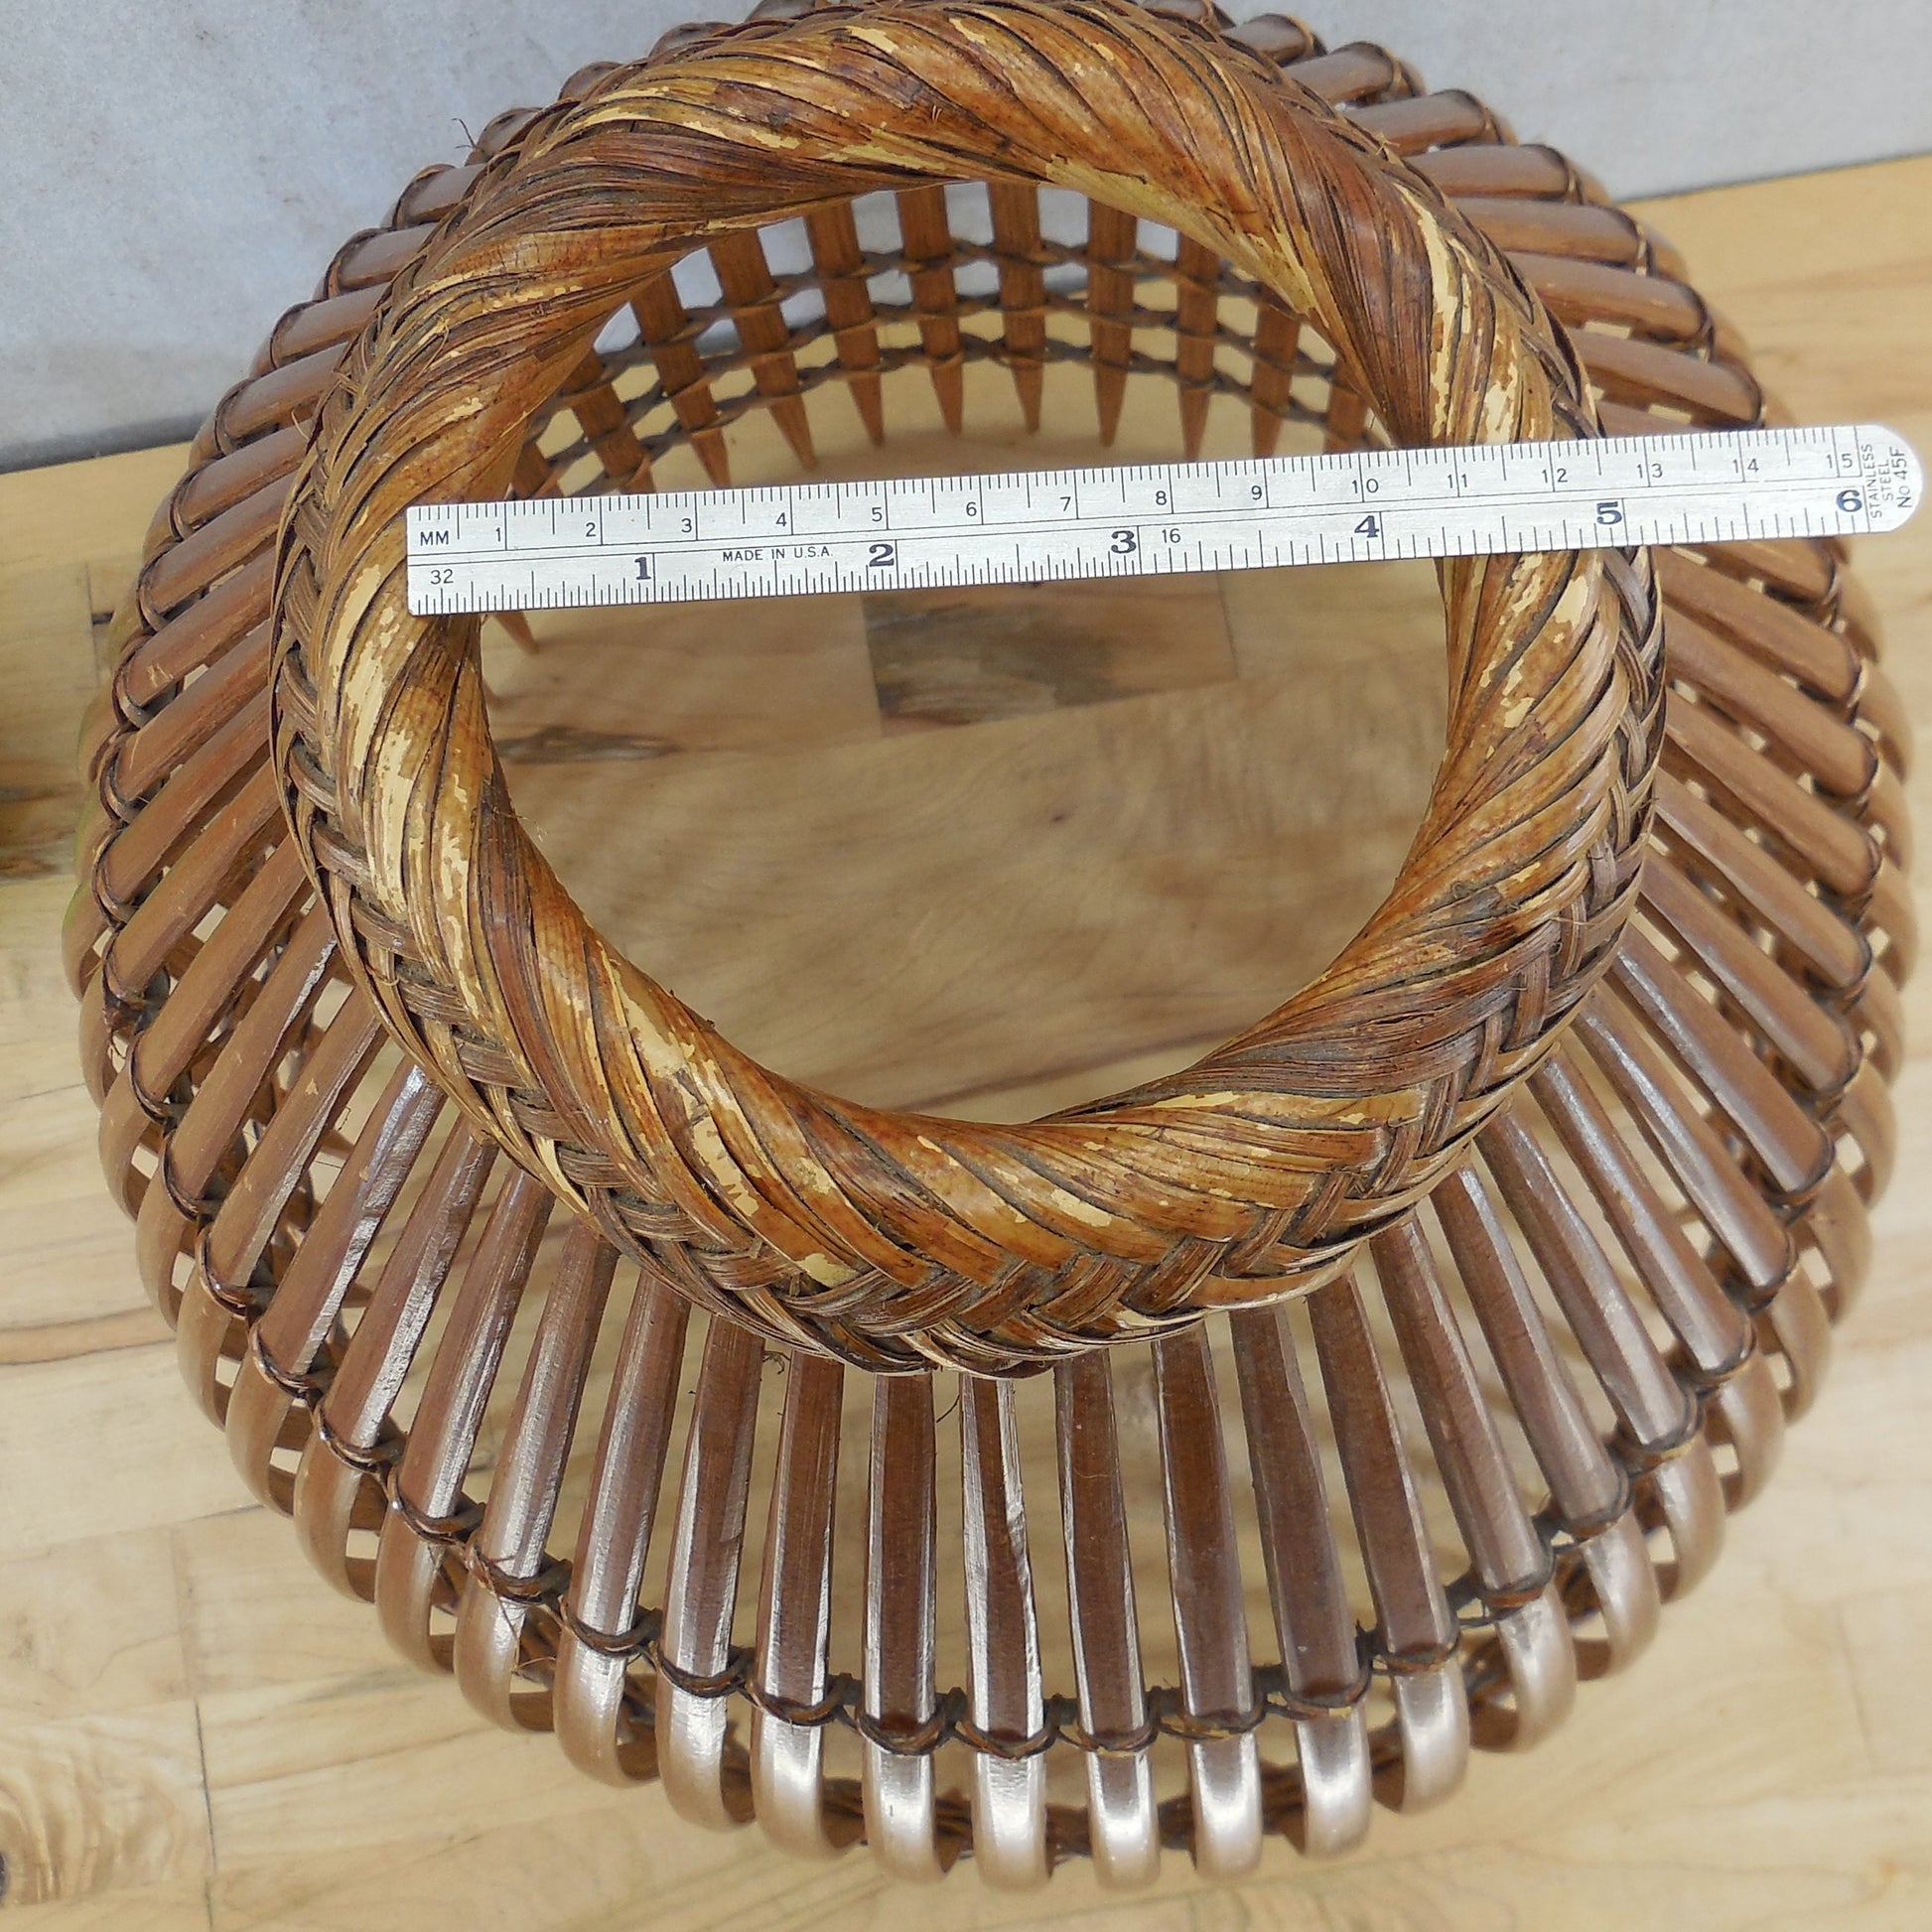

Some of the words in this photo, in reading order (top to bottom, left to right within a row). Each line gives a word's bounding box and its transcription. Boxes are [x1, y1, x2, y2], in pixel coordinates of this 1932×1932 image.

[1861, 444, 1882, 518] STAINLESS
[1878, 459, 1894, 501] STEEL
[1889, 446, 1908, 481] 45F
[420, 530, 450, 546] MM
[495, 526, 501, 542] 1
[586, 522, 597, 537] 2
[681, 517, 692, 533] 3
[775, 512, 787, 527] 4
[872, 506, 883, 522] 5
[965, 501, 977, 517] 6
[1059, 496, 1071, 512] 7
[1156, 490, 1168, 506] 8
[1251, 484, 1263, 500] 9
[430, 568, 454, 585] 32
[633, 556, 651, 581] 1
[869, 543, 894, 567] 2
[1110, 530, 1137, 554] 3
[1162, 528, 1181, 544] 16
[1354, 515, 1380, 538] 4
[1596, 500, 1622, 525] 5
[1836, 489, 1863, 512] 6
[723, 549, 763, 562] MADE
[771, 548, 785, 560] IN
[793, 546, 833, 558] U.S.A.
